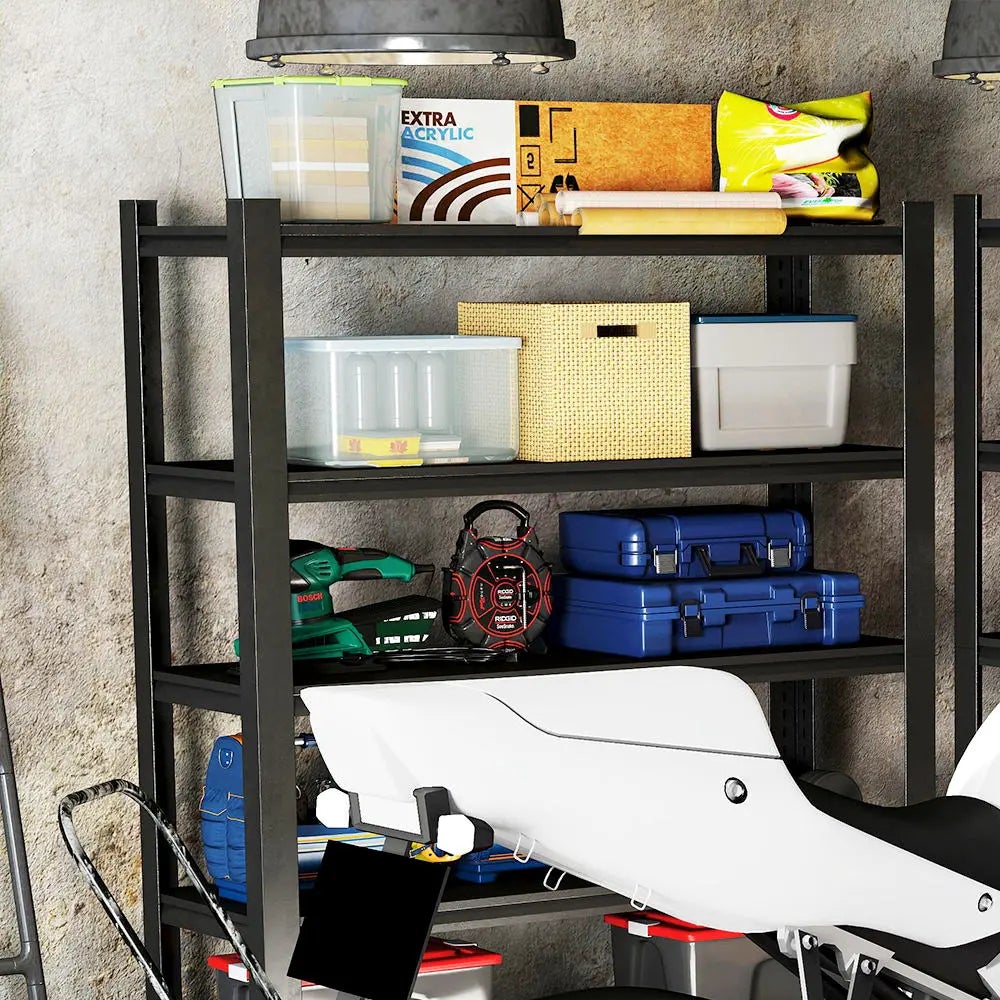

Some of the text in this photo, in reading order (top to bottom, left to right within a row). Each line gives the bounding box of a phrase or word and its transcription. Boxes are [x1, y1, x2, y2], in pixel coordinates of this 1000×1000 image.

[401, 110, 457, 126] EXTRA
[401, 127, 475, 141] ACRYLIC
[297, 592, 323, 603] BOSCH
